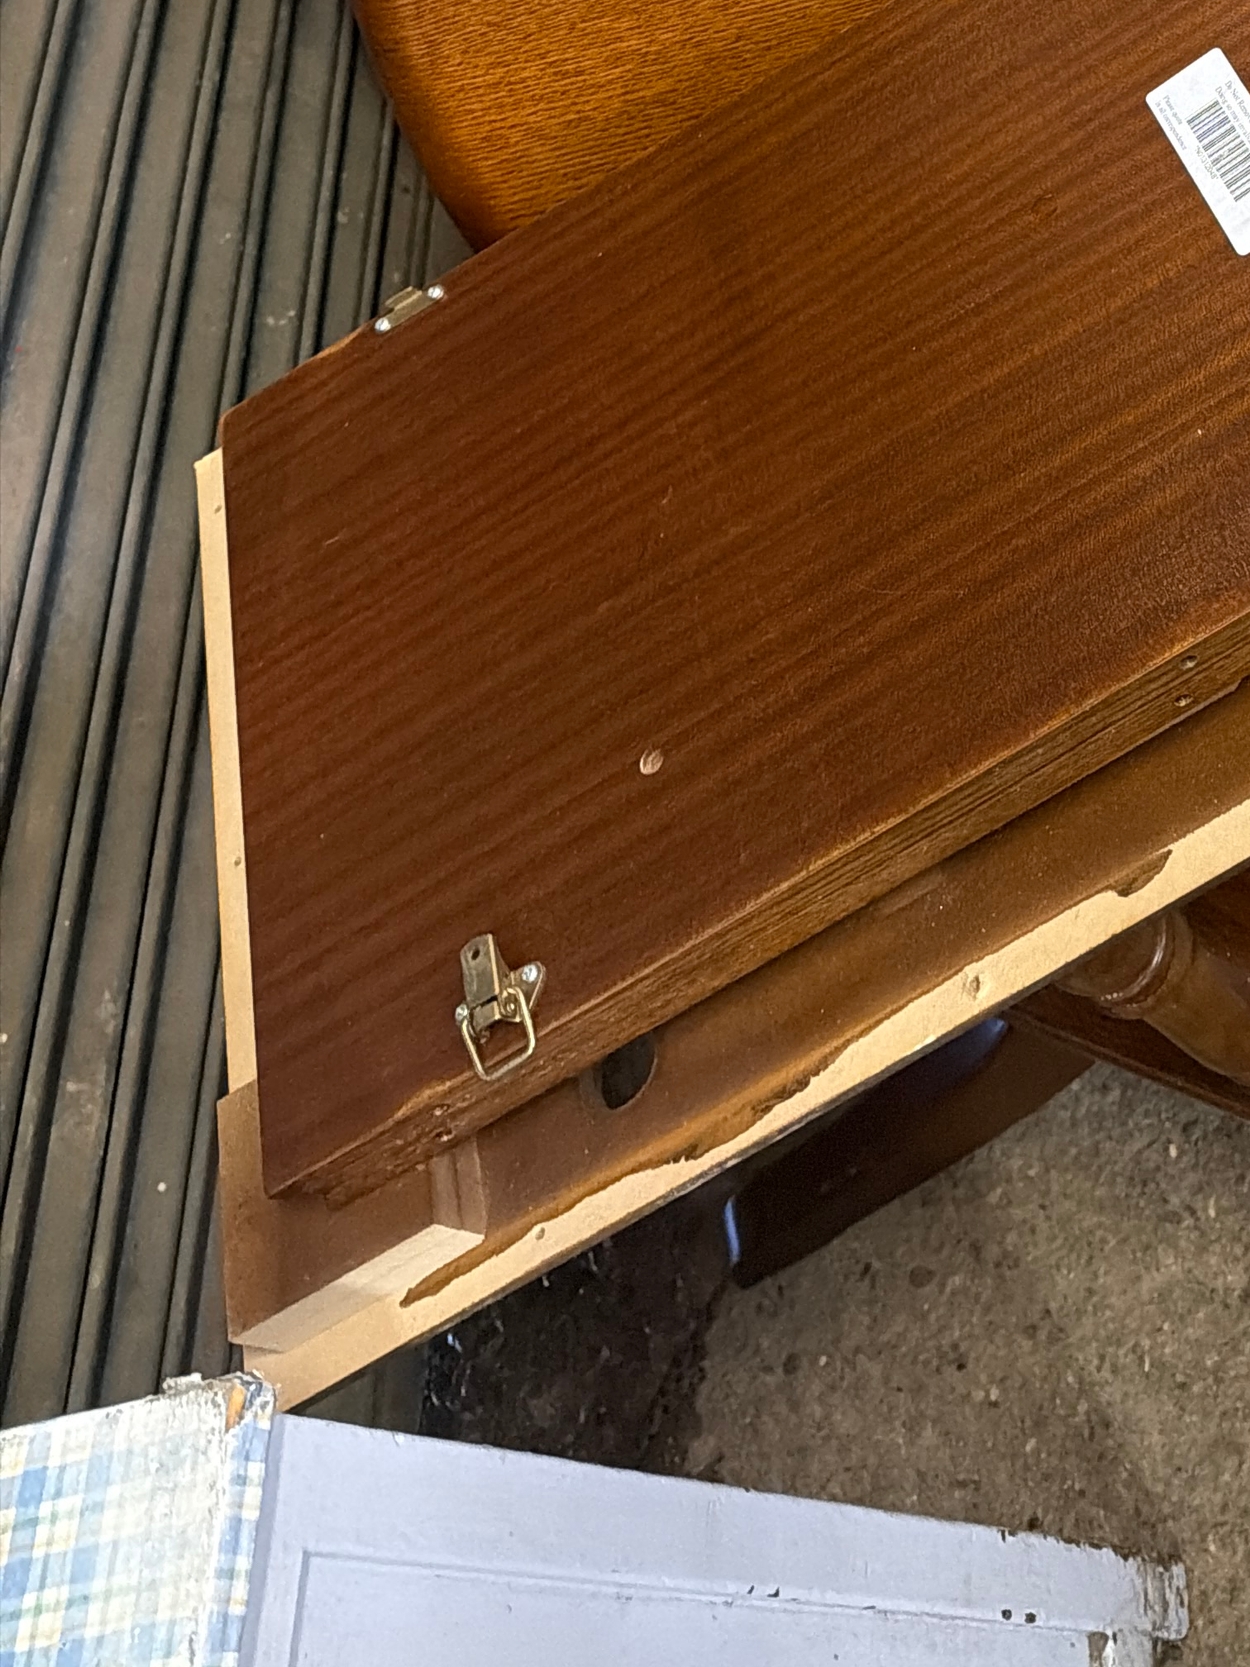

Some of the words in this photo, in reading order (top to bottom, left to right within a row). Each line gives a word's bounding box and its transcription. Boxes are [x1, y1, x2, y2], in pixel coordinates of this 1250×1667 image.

[1215, 86, 1228, 104] Doing
[1230, 110, 1239, 122] may
[1225, 80, 1232, 90] Do
[1230, 88, 1240, 101] Not
[1163, 95, 1175, 111] Please
[1172, 112, 1183, 125] quote
